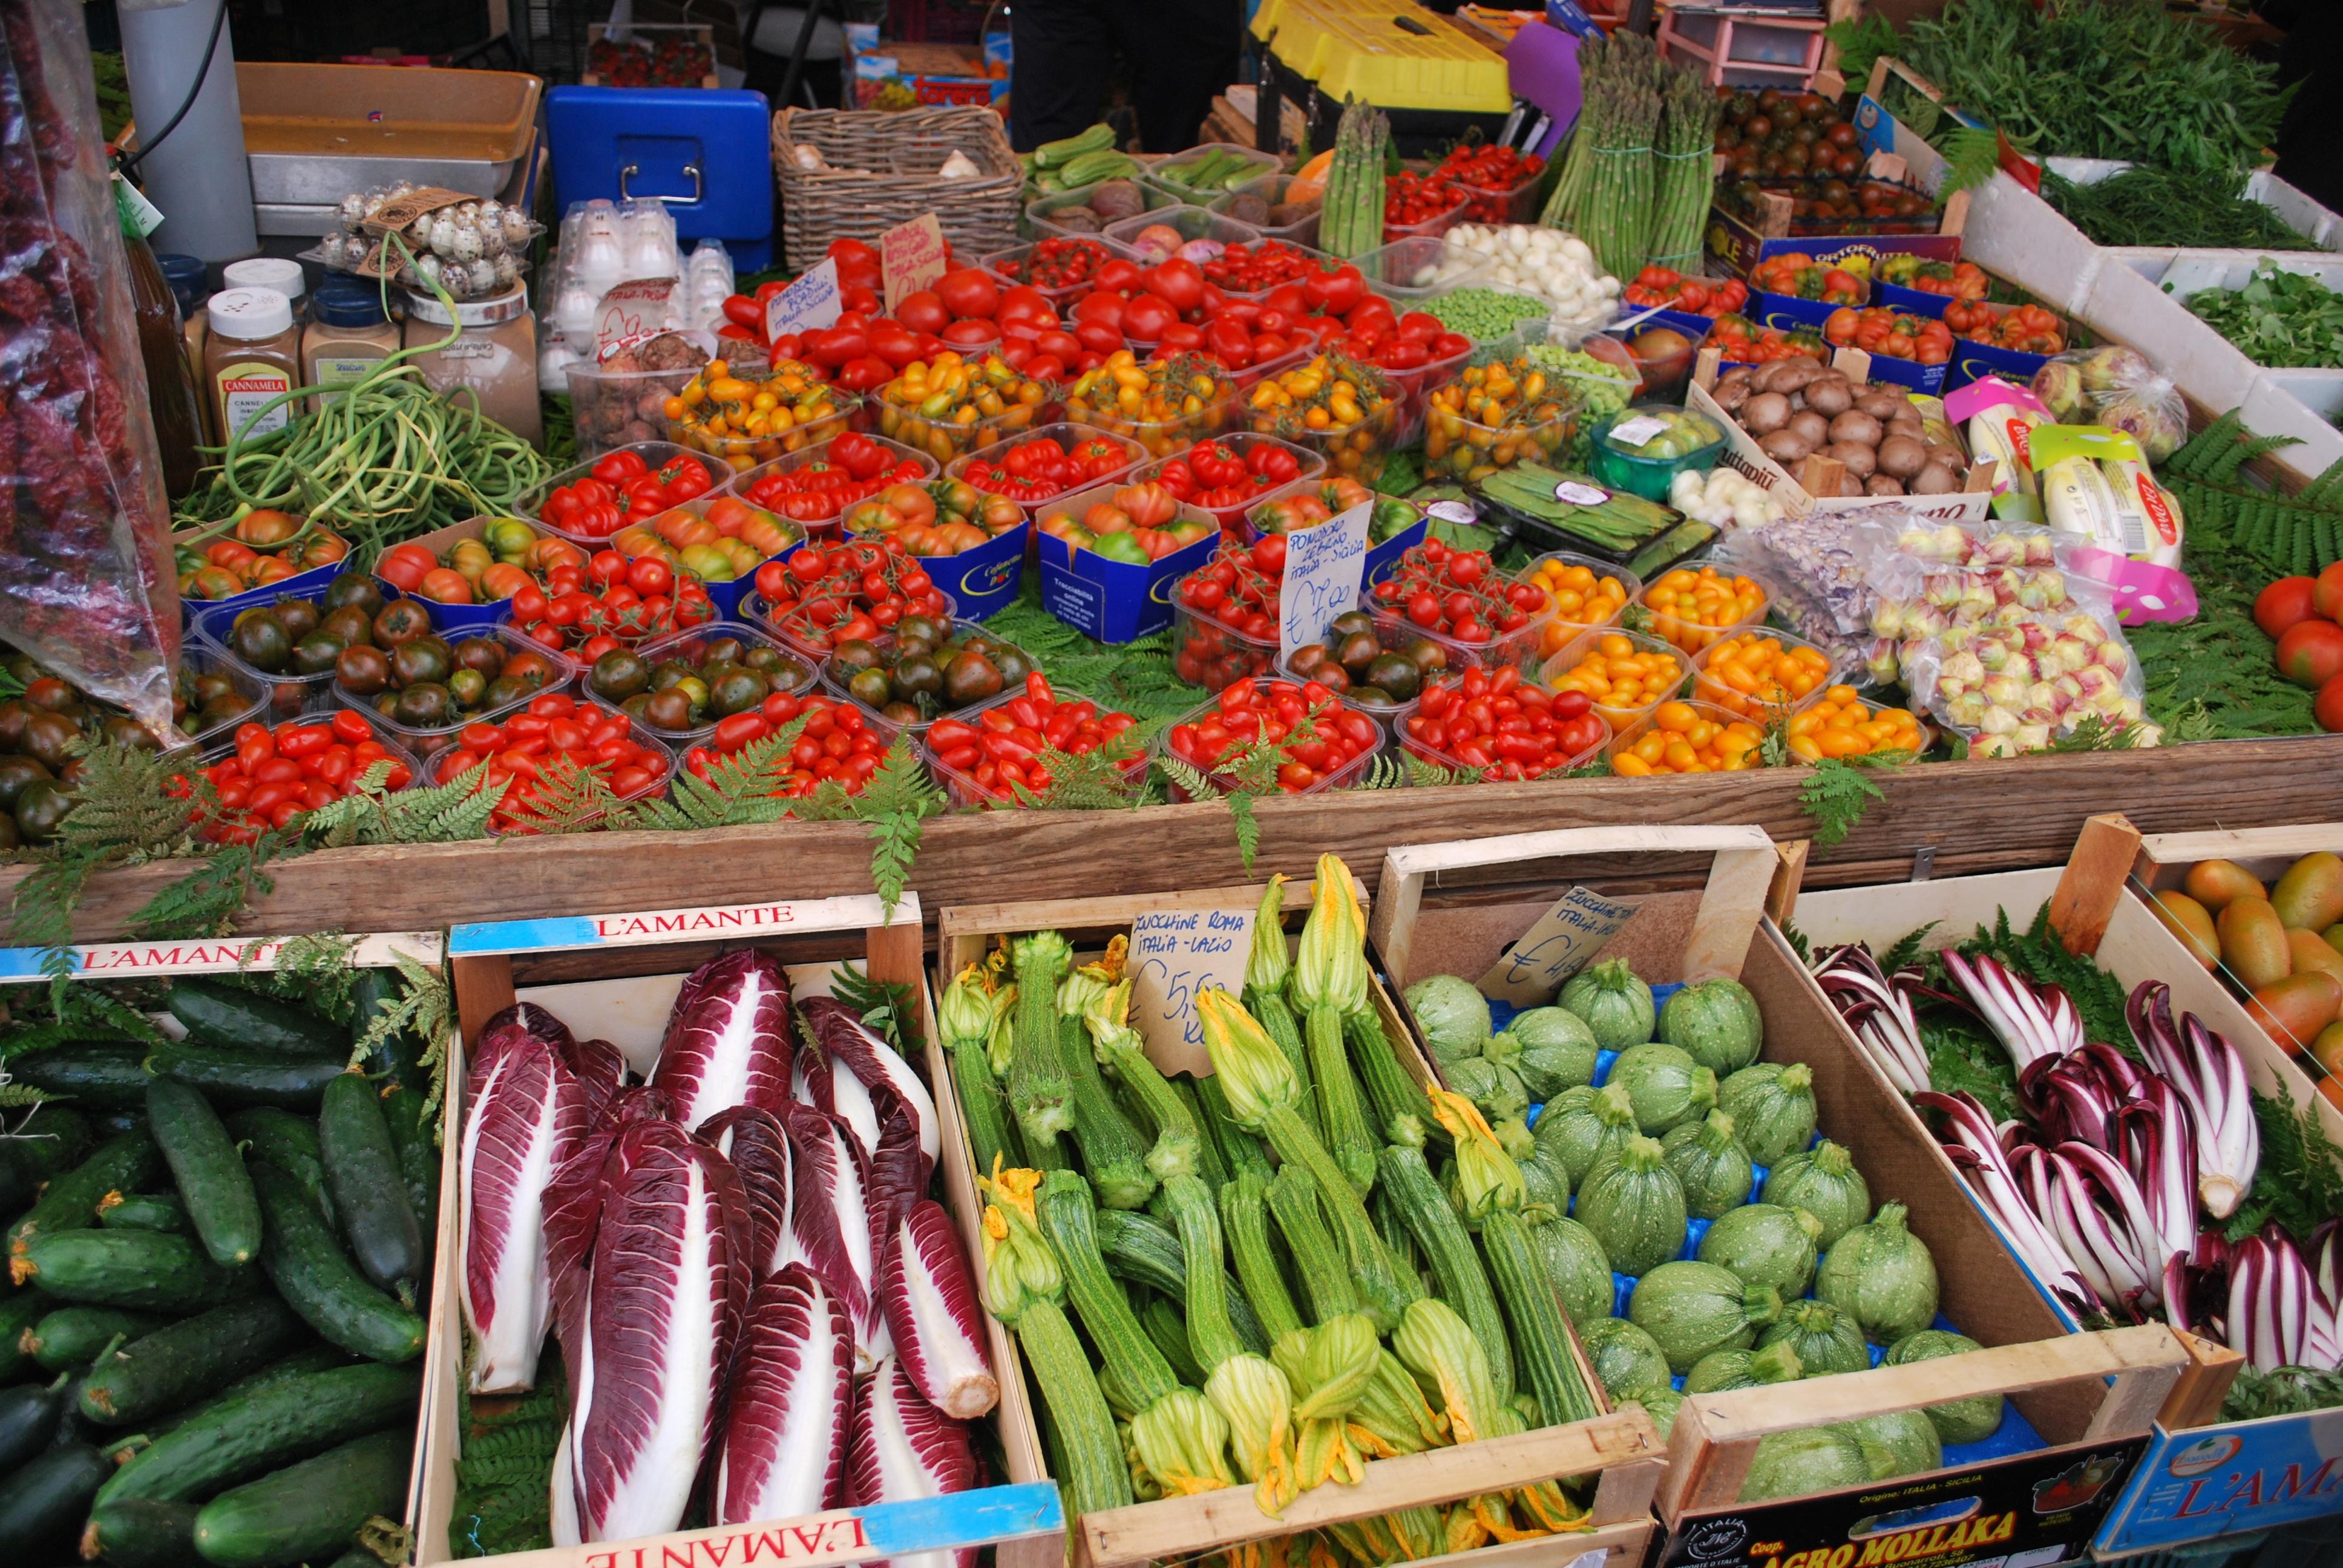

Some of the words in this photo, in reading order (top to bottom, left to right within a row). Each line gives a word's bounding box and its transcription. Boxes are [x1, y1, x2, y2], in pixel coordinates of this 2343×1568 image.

[913, 75, 991, 106] torero
[225, 379, 284, 391] CANNAMELA
[595, 906, 795, 937] L'AMANTE
[1133, 913, 1199, 934] ZUCCHINE
[1207, 910, 1245, 933] ROMA
[82, 942, 286, 970] L'AMANT
[1902, 1483, 1938, 1495] ITALIA
[1944, 1474, 1983, 1488] SICILIA
[1750, 1541, 1783, 1555] Coop.
